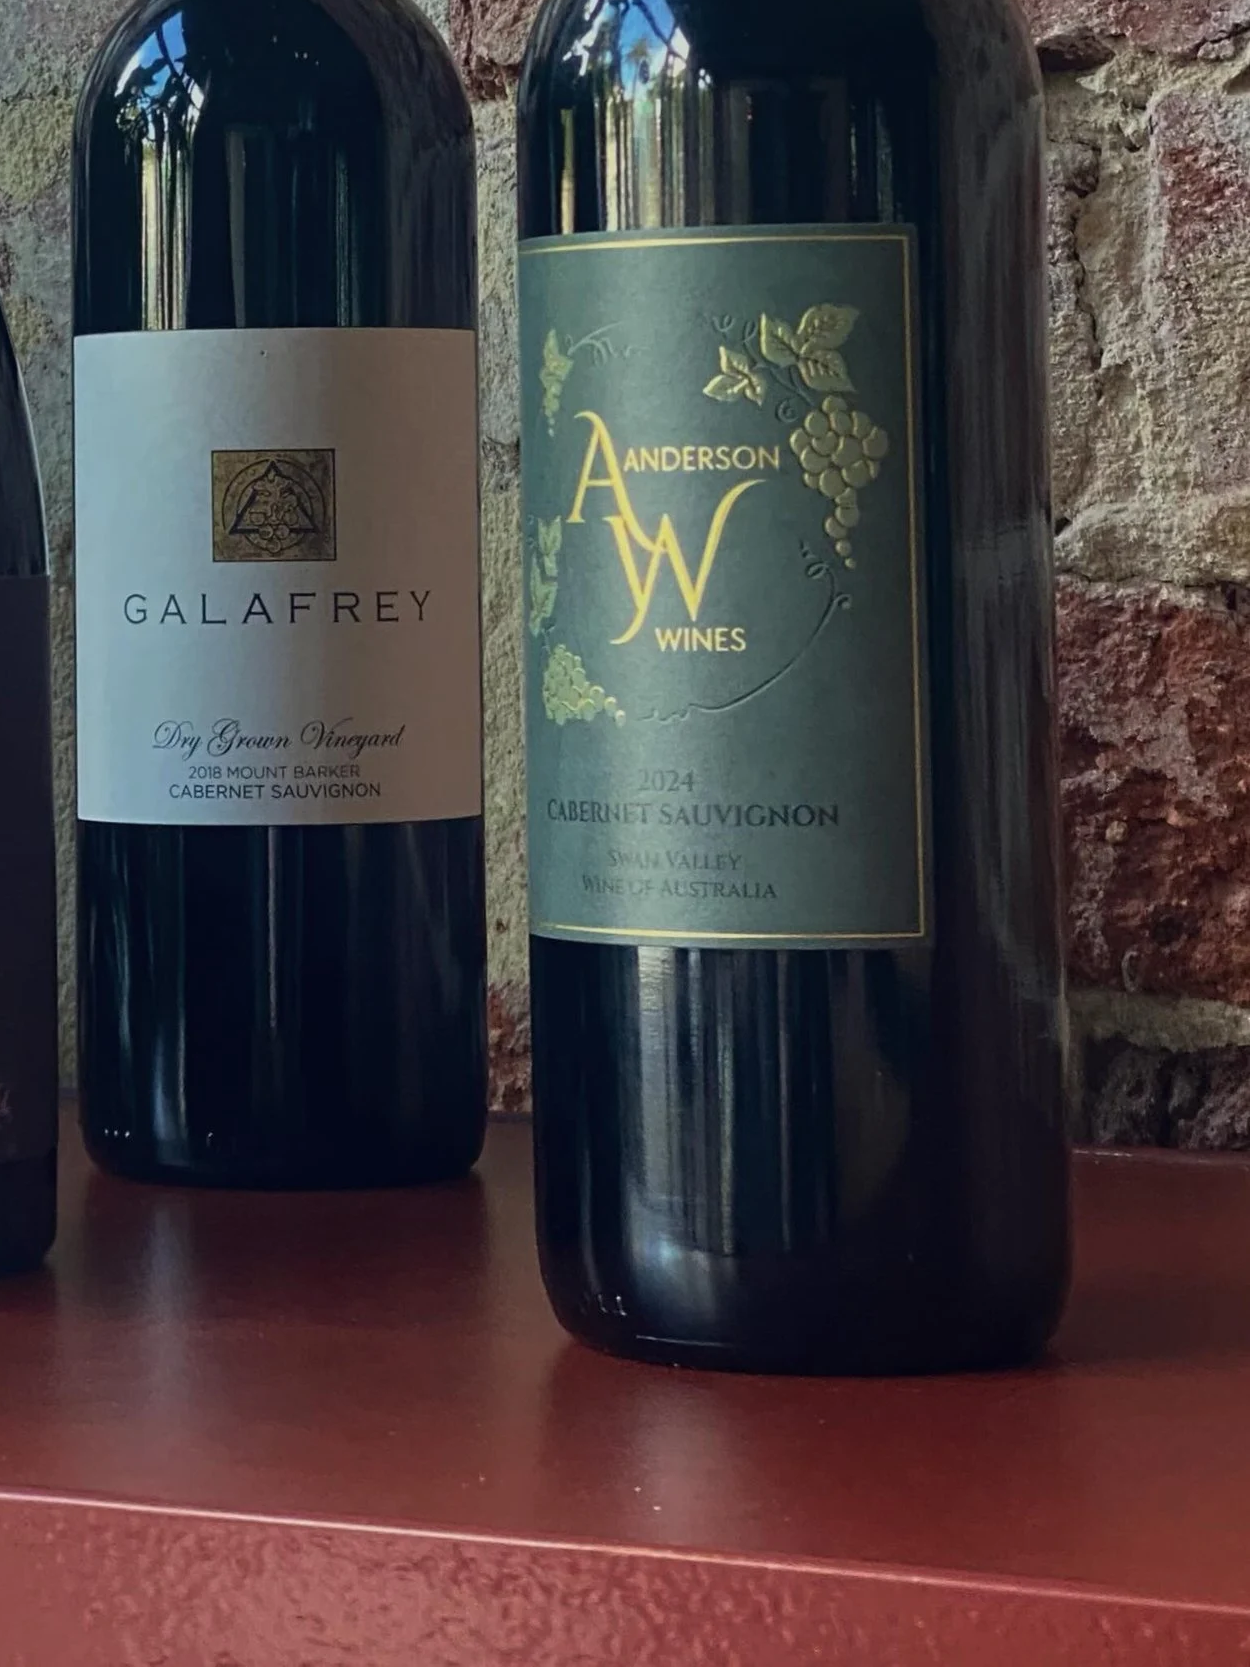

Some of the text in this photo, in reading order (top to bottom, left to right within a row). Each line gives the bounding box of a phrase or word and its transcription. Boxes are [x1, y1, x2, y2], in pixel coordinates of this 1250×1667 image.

[623, 445, 780, 472] ANDERSON
[123, 589, 432, 626] GALAFREY
[654, 627, 747, 652] WINES
[152, 717, 406, 761] Dry Grown Vineyard
[188, 764, 361, 780] 2018 MOUNT BARKER
[637, 768, 695, 793] 2024
[168, 783, 382, 800] CABERNET SAUVIGNON
[546, 798, 840, 828] CABERNET SAUVIGNON
[665, 851, 743, 871] VALLEY
[661, 880, 778, 900] AUSTRALIA
